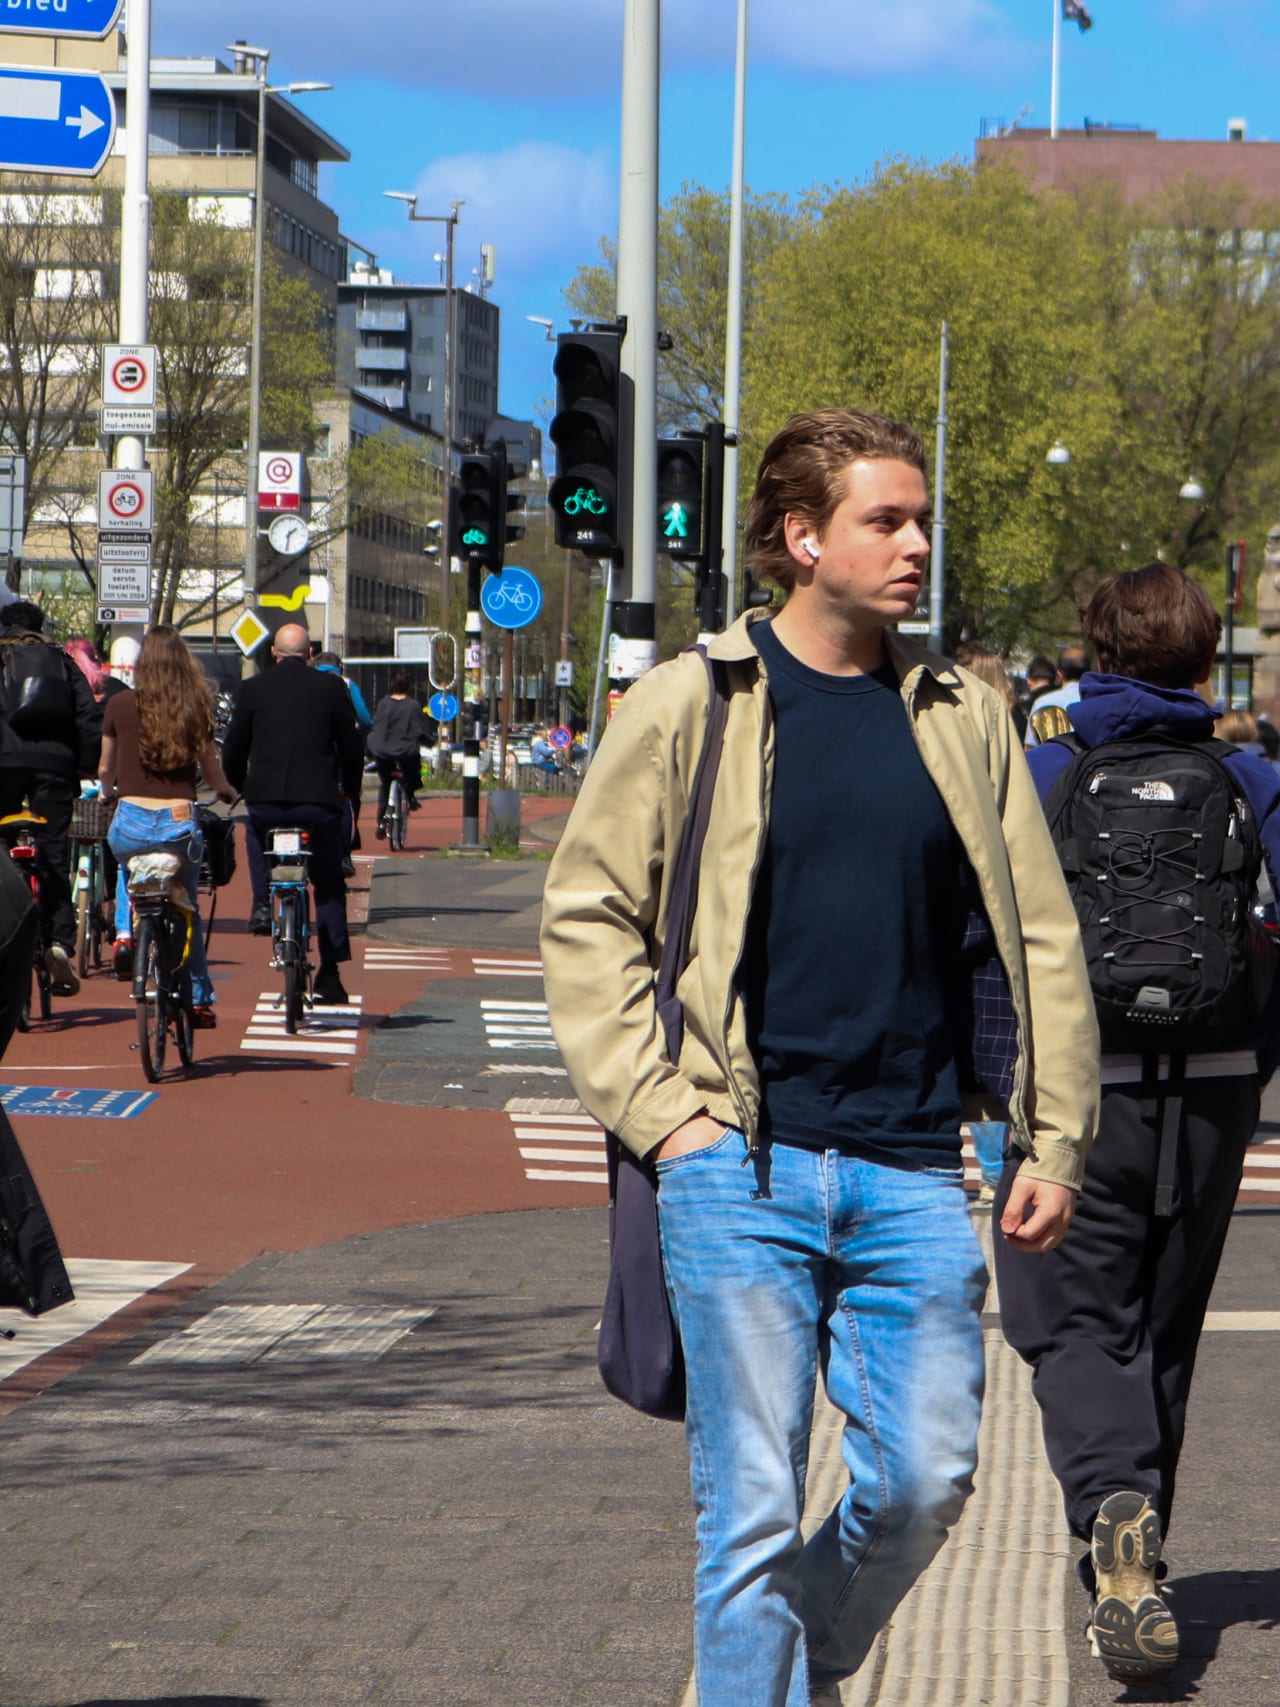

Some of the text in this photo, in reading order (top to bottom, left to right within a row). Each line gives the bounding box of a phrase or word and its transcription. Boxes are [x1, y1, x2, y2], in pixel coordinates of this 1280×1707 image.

[119, 348, 140, 356] ZONE
[106, 410, 152, 420] toegestaan
[105, 422, 152, 430] nul-emissie
[115, 473, 137, 481] ZONE
[108, 519, 143, 528] herhaling
[101, 533, 149, 543] uitgezonderd
[576, 531, 593, 541] 241
[103, 549, 146, 559] uitstootvrij
[112, 566, 136, 575] datum
[112, 575, 136, 583] eerste
[107, 583, 141, 592] toelating
[1143, 780, 1160, 790] THE
[1131, 786, 1160, 796] NORTH
